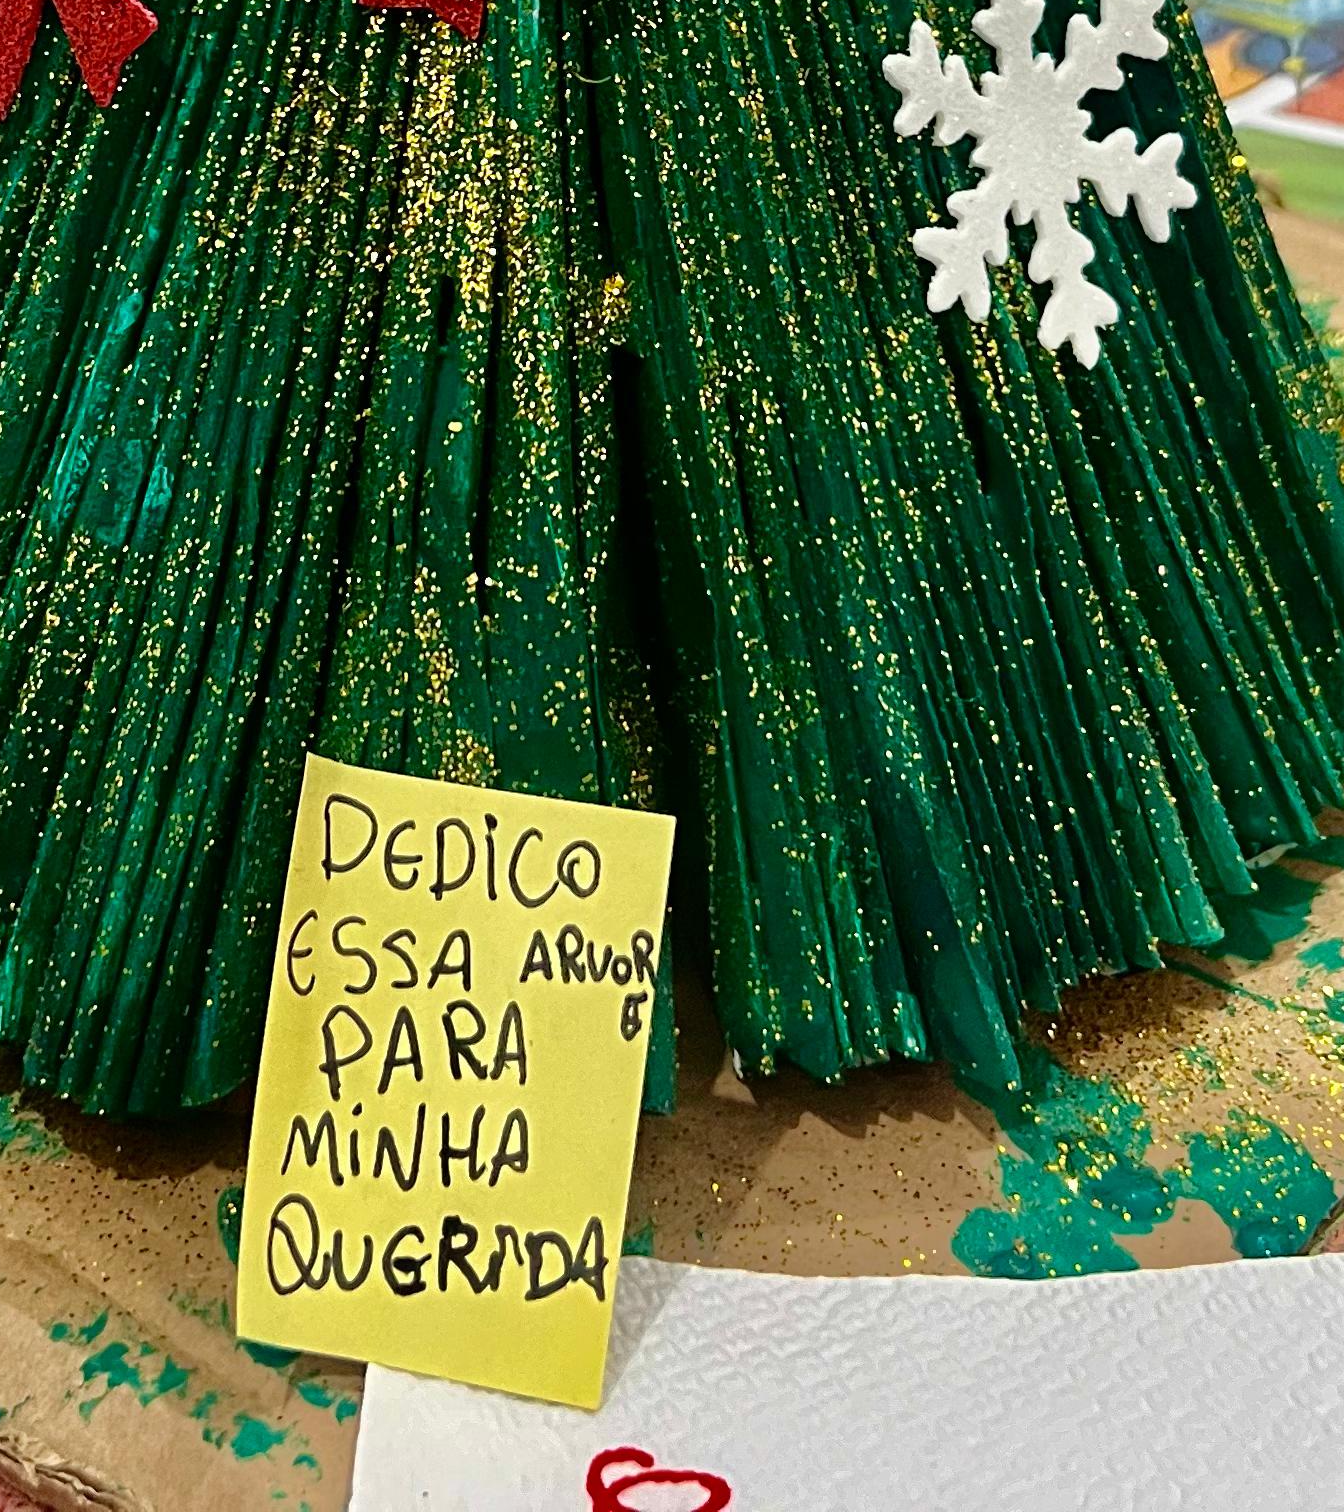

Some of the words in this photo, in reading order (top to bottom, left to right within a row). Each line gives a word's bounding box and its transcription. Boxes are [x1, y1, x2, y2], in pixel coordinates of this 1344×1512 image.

[321, 793, 603, 908] DEDICO
[286, 908, 474, 996] ESSA
[317, 999, 530, 1101] PARA
[281, 1101, 531, 1191] MINHA
